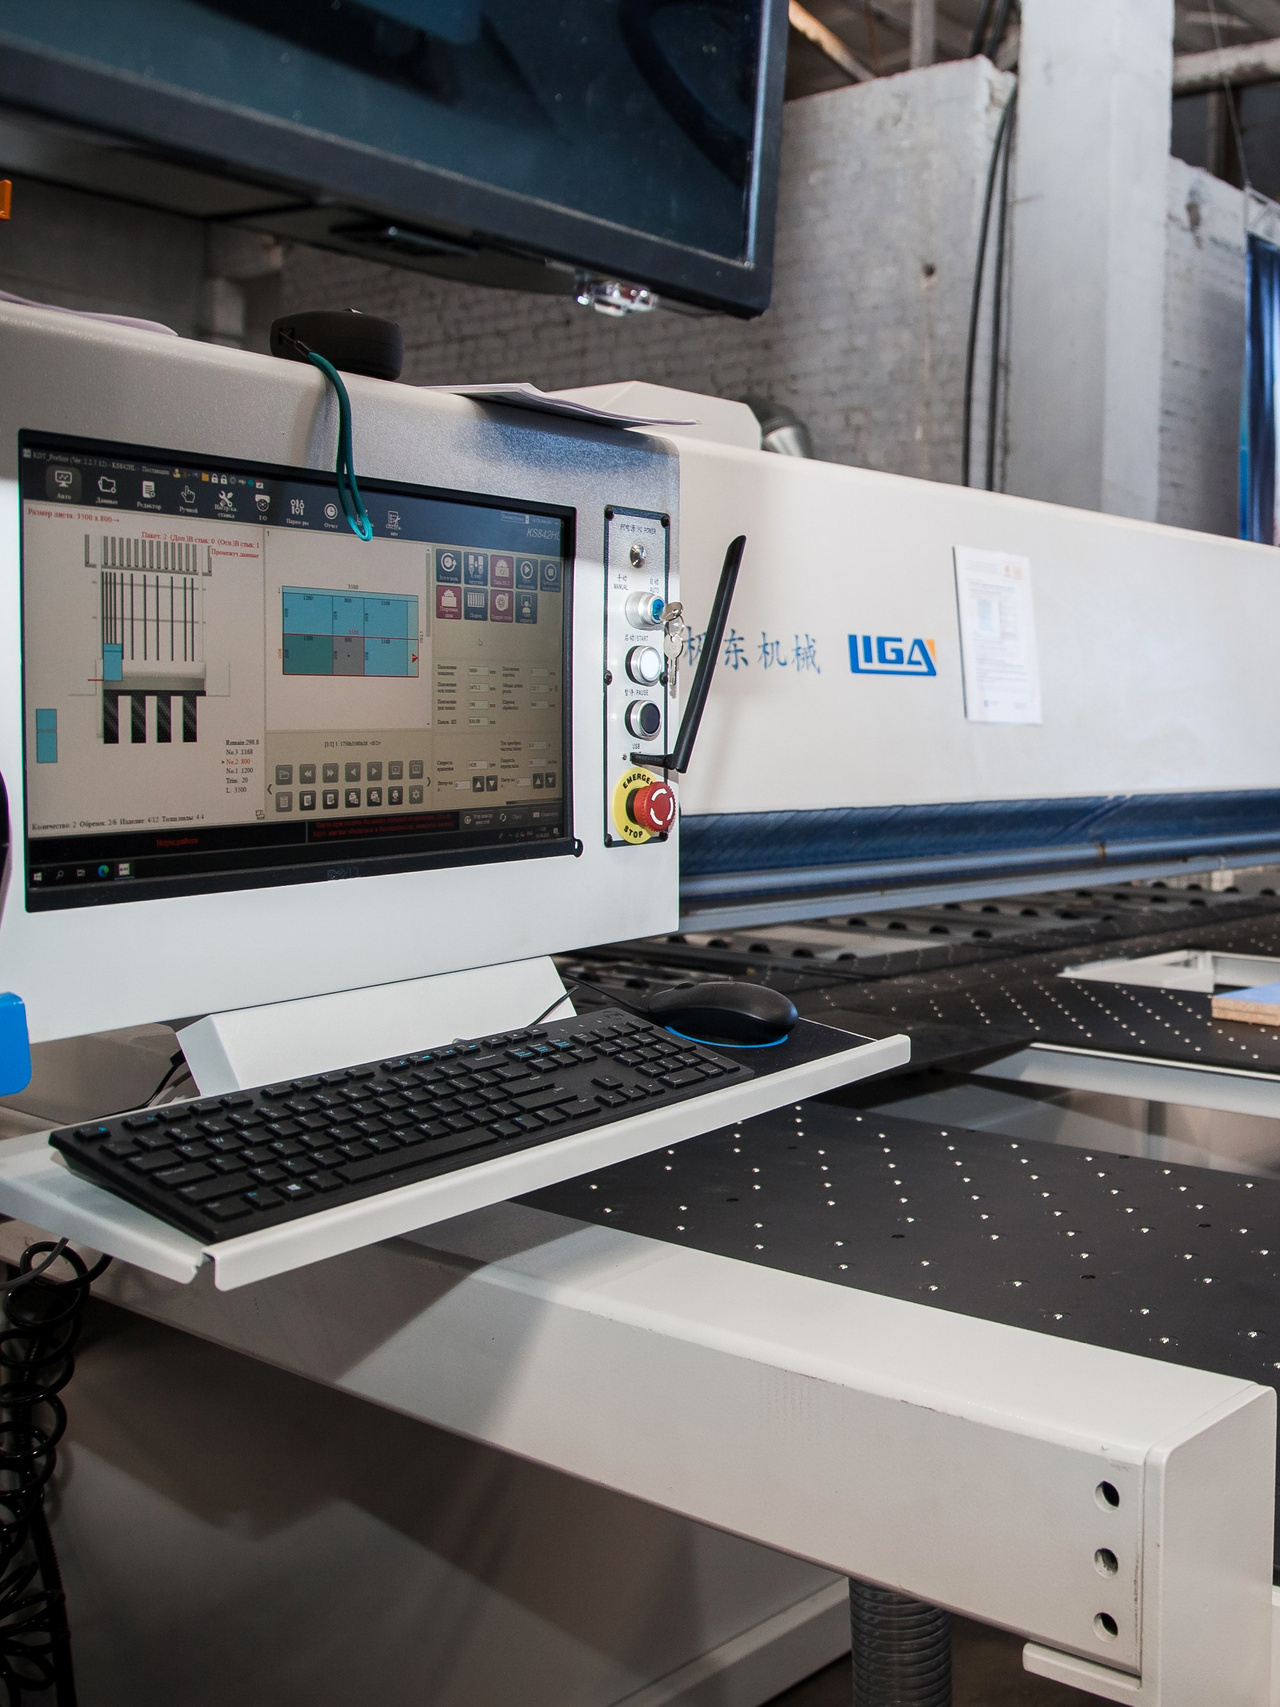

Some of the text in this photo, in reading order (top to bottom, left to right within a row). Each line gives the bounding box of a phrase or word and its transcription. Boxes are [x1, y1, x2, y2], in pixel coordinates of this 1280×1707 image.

[526, 527, 560, 541] KS842HL
[847, 634, 937, 676] LIGA
[623, 825, 644, 840] STOP
